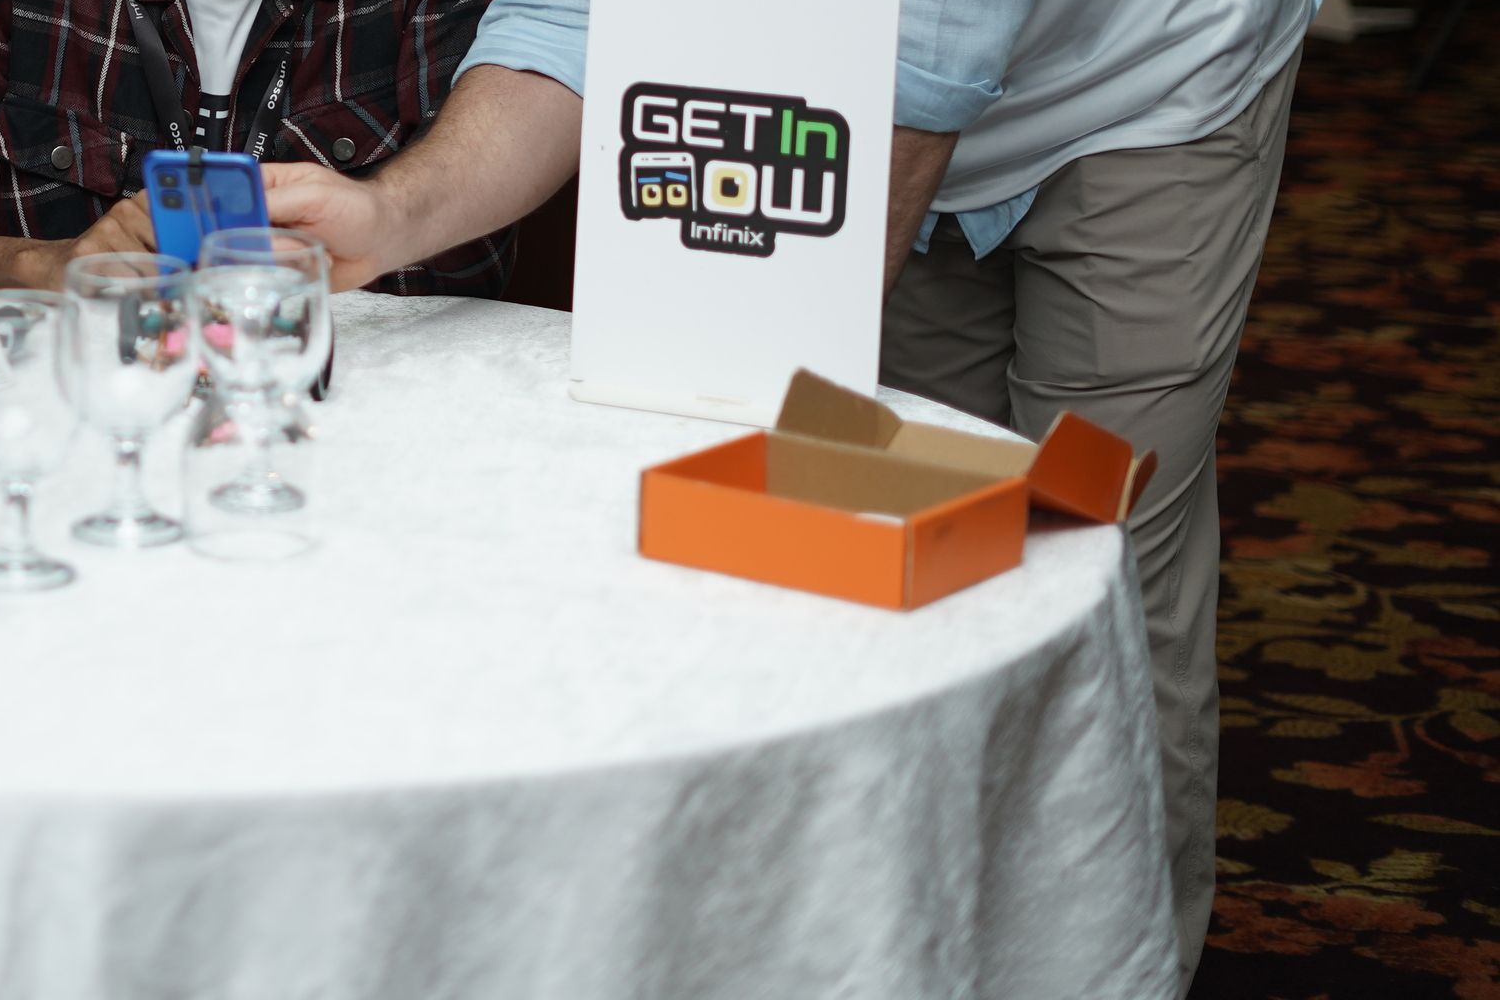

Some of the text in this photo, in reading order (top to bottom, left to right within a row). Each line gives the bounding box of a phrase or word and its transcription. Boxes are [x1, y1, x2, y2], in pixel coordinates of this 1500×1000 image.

[267, 60, 287, 110] unesco
[169, 122, 185, 152] esco
[631, 94, 838, 160] GET In
[690, 221, 765, 247] Infinix
